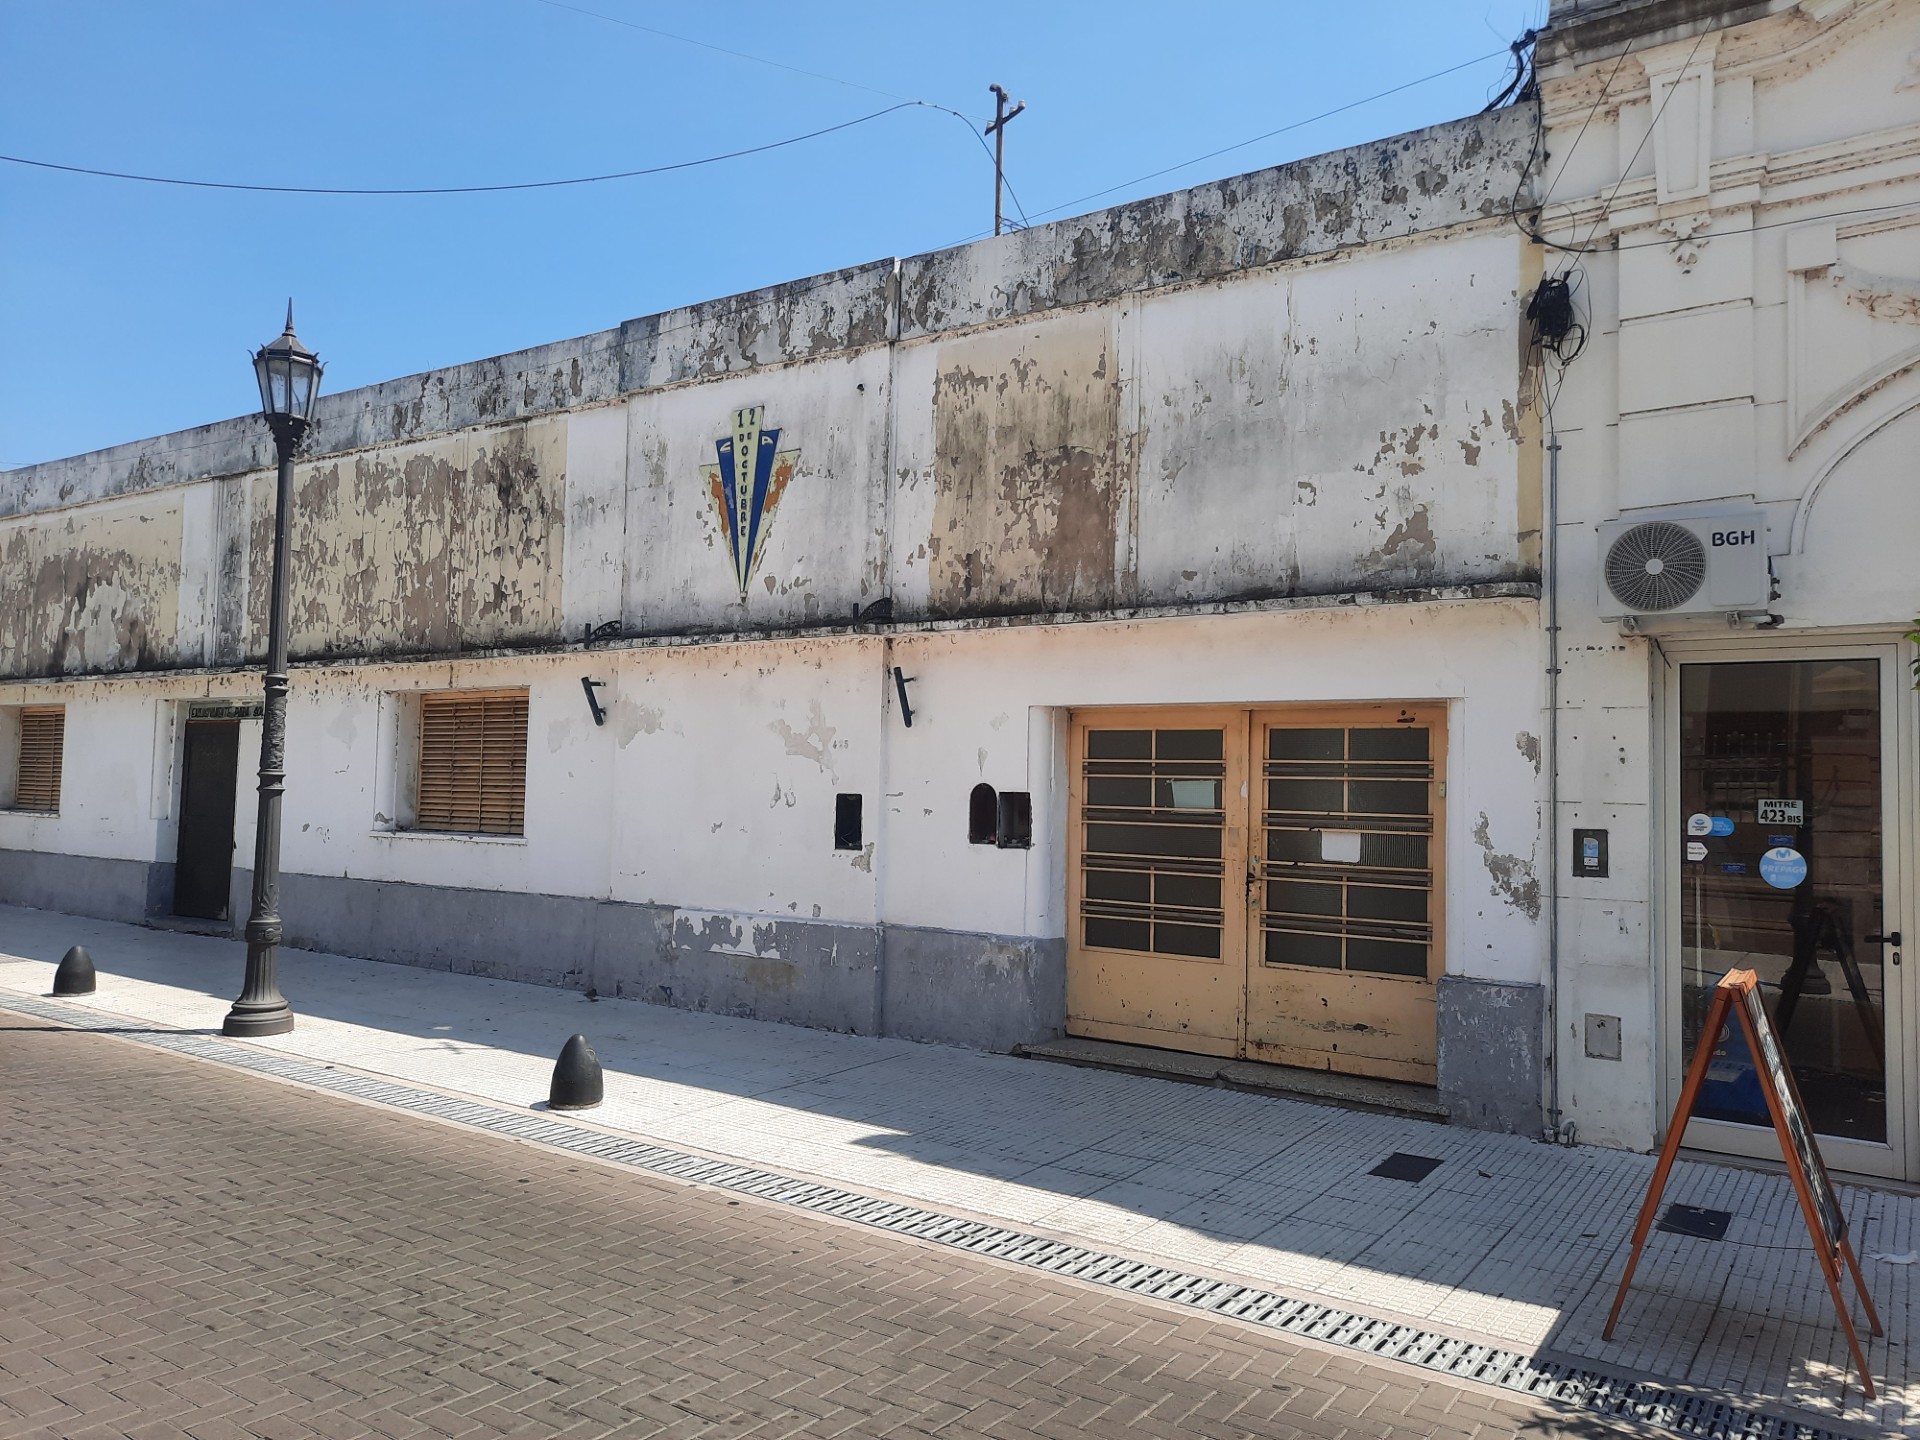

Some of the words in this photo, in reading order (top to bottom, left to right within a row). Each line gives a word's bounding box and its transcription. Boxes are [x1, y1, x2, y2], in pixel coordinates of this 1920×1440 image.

[738, 408, 755, 428] 12
[740, 445, 748, 537] OCTUBRE
[1712, 530, 1755, 547] BGH
[1763, 801, 1797, 809] MITRE
[1760, 809, 1786, 823] 423
[1787, 815, 1802, 823] BIS
[1762, 865, 1805, 874] PREPAGO
